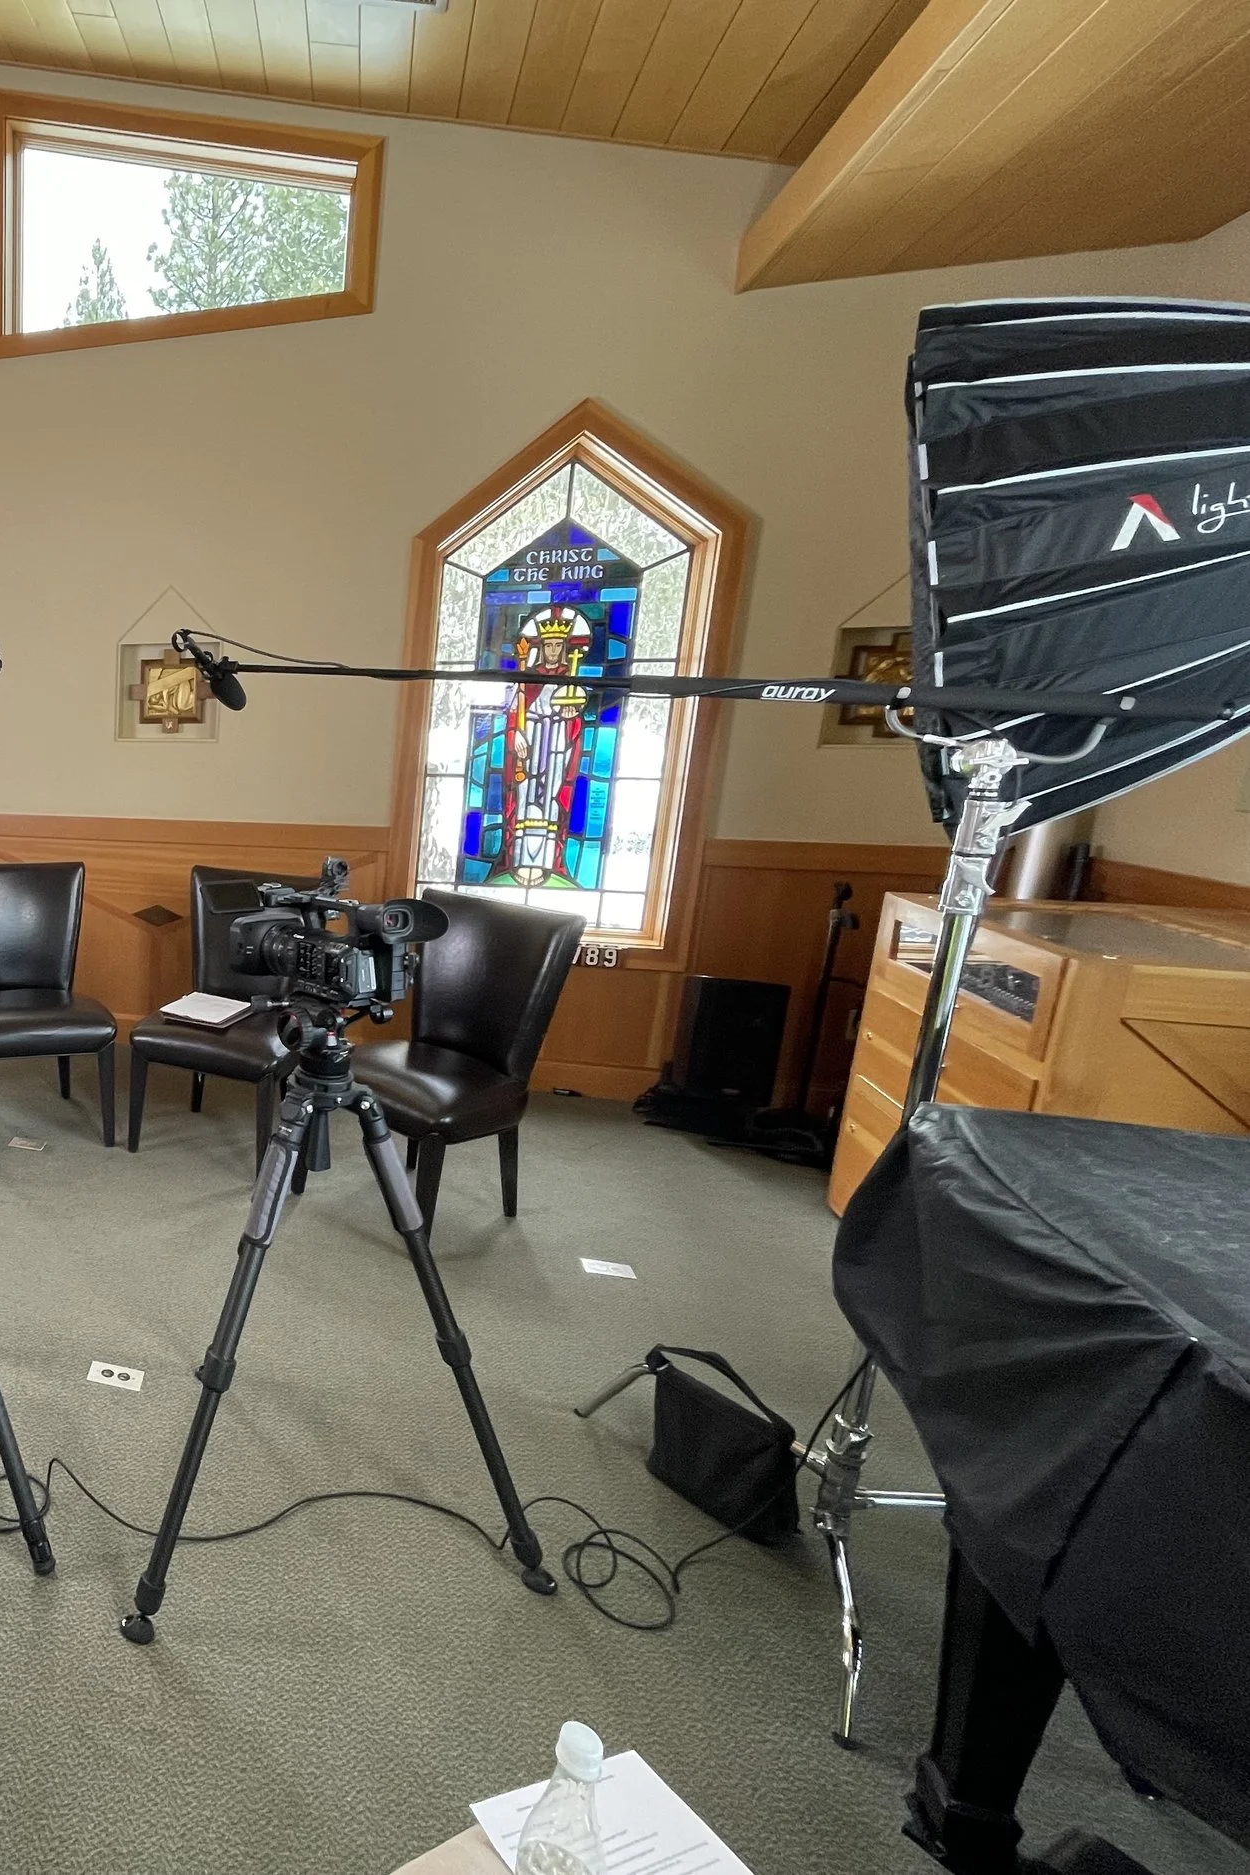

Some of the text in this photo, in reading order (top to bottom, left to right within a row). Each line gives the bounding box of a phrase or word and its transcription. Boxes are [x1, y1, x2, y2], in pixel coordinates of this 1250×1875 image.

[1192, 481, 1250, 533] ligh
[526, 547, 593, 565] CHRIST
[513, 564, 604, 582] THE KING
[760, 685, 837, 703] auray
